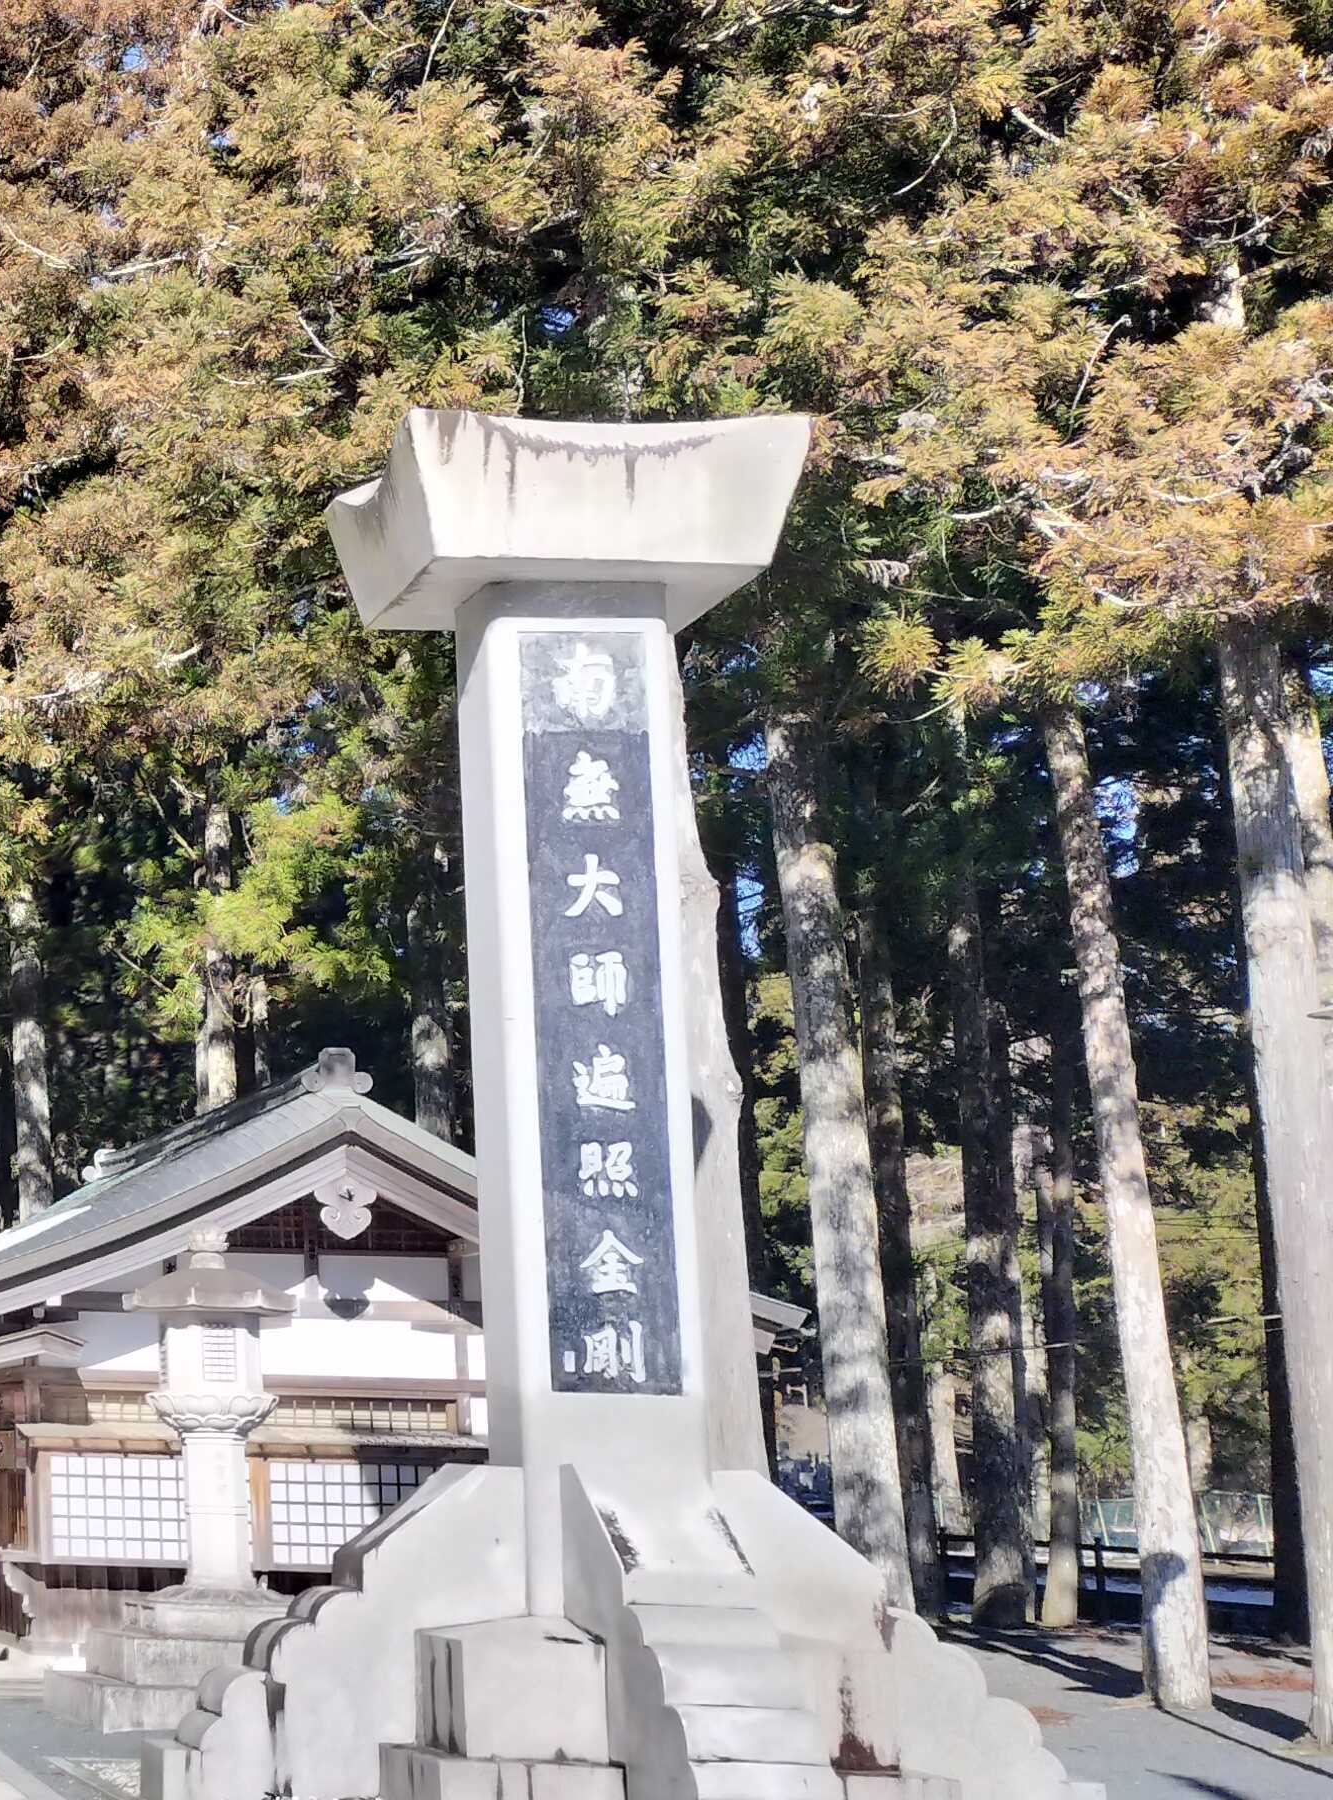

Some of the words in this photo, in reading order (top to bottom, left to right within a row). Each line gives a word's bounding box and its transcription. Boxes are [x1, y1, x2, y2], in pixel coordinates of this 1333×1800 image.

[551, 642, 646, 1385] 南無大師遍照金剛
